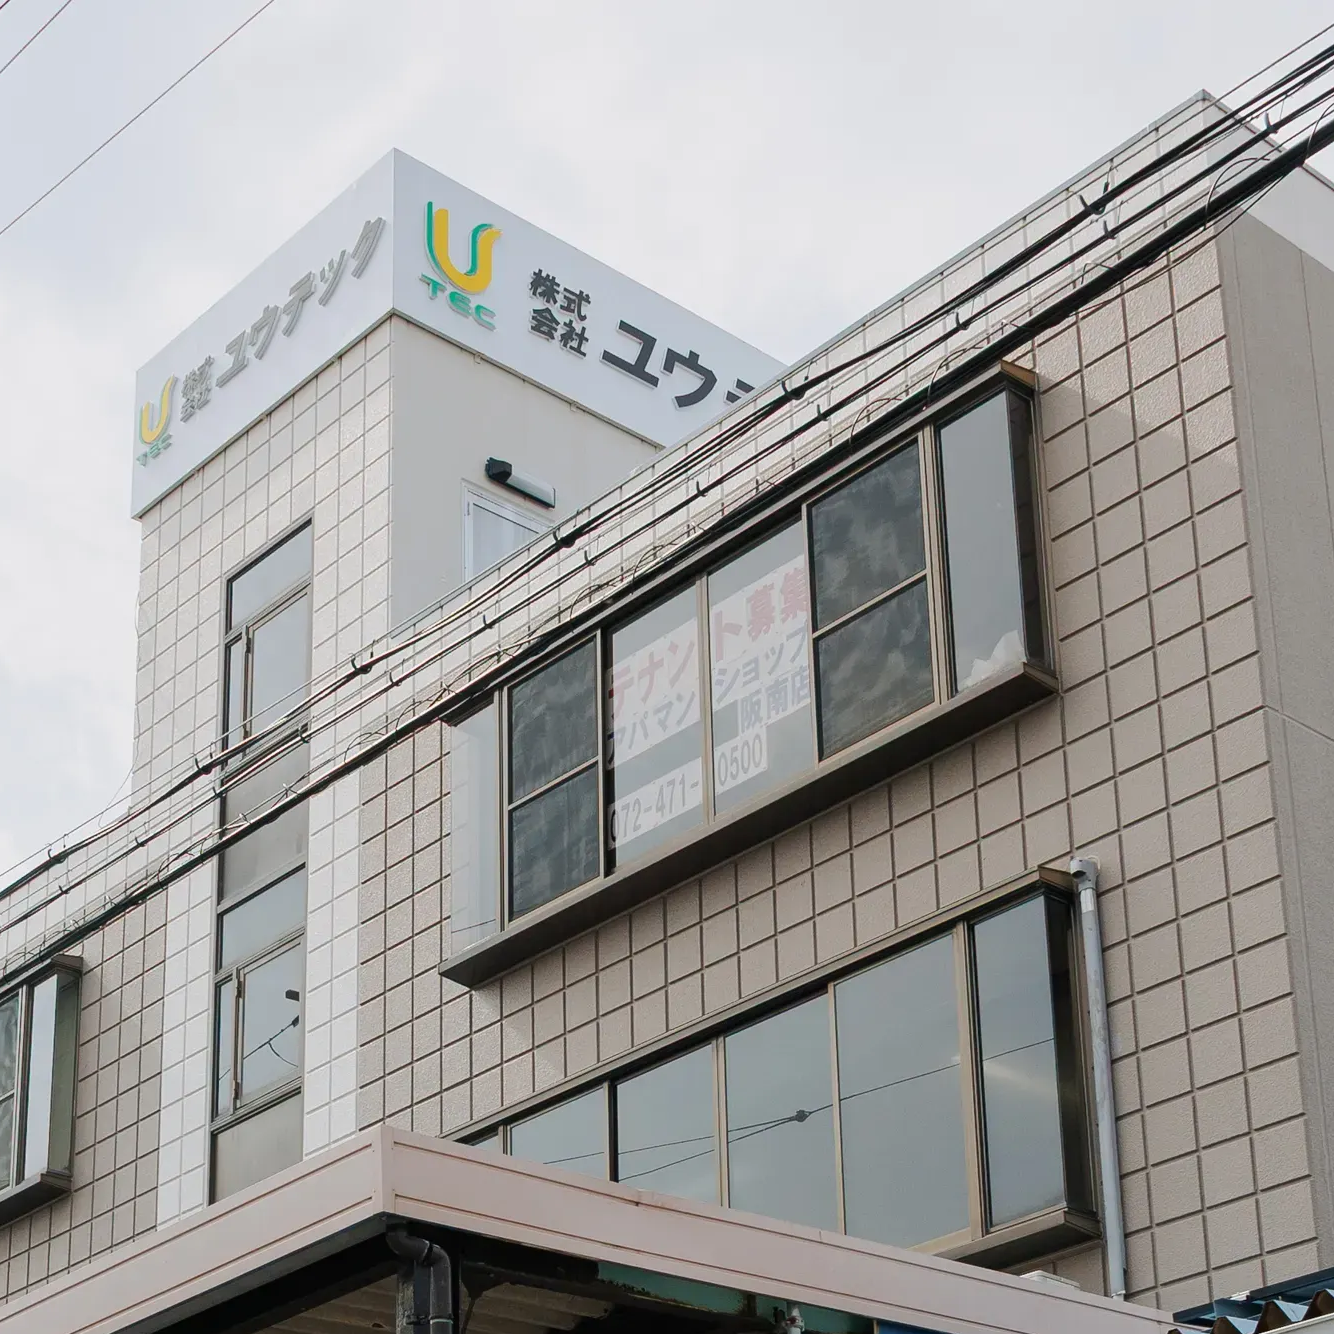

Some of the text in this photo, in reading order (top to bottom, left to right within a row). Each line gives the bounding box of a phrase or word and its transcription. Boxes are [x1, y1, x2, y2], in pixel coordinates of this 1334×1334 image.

[216, 216, 386, 388] ユウテック
[419, 272, 497, 331] TEC
[529, 268, 592, 323] 株式
[528, 306, 590, 359] 会社
[739, 664, 810, 734] 阪南店
[611, 732, 764, 843] 072-471-0500
